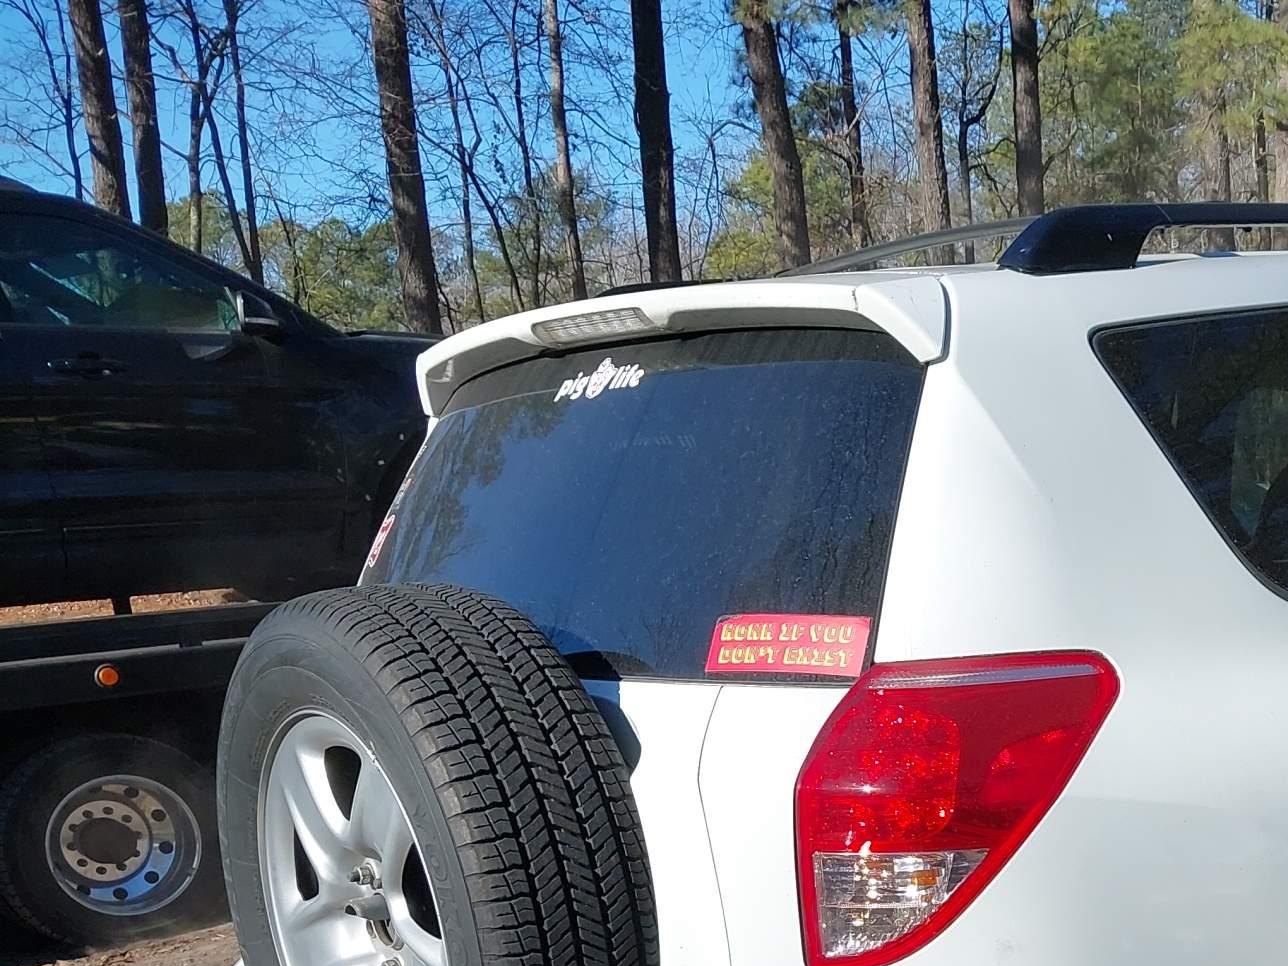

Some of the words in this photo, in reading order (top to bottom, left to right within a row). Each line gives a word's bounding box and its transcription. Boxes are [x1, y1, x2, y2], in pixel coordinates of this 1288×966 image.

[553, 371, 590, 402] pig
[608, 363, 645, 388] life
[720, 623, 773, 641] HONK
[778, 623, 805, 641] IF
[809, 624, 853, 643] YOU
[783, 647, 853, 667] EXIST
